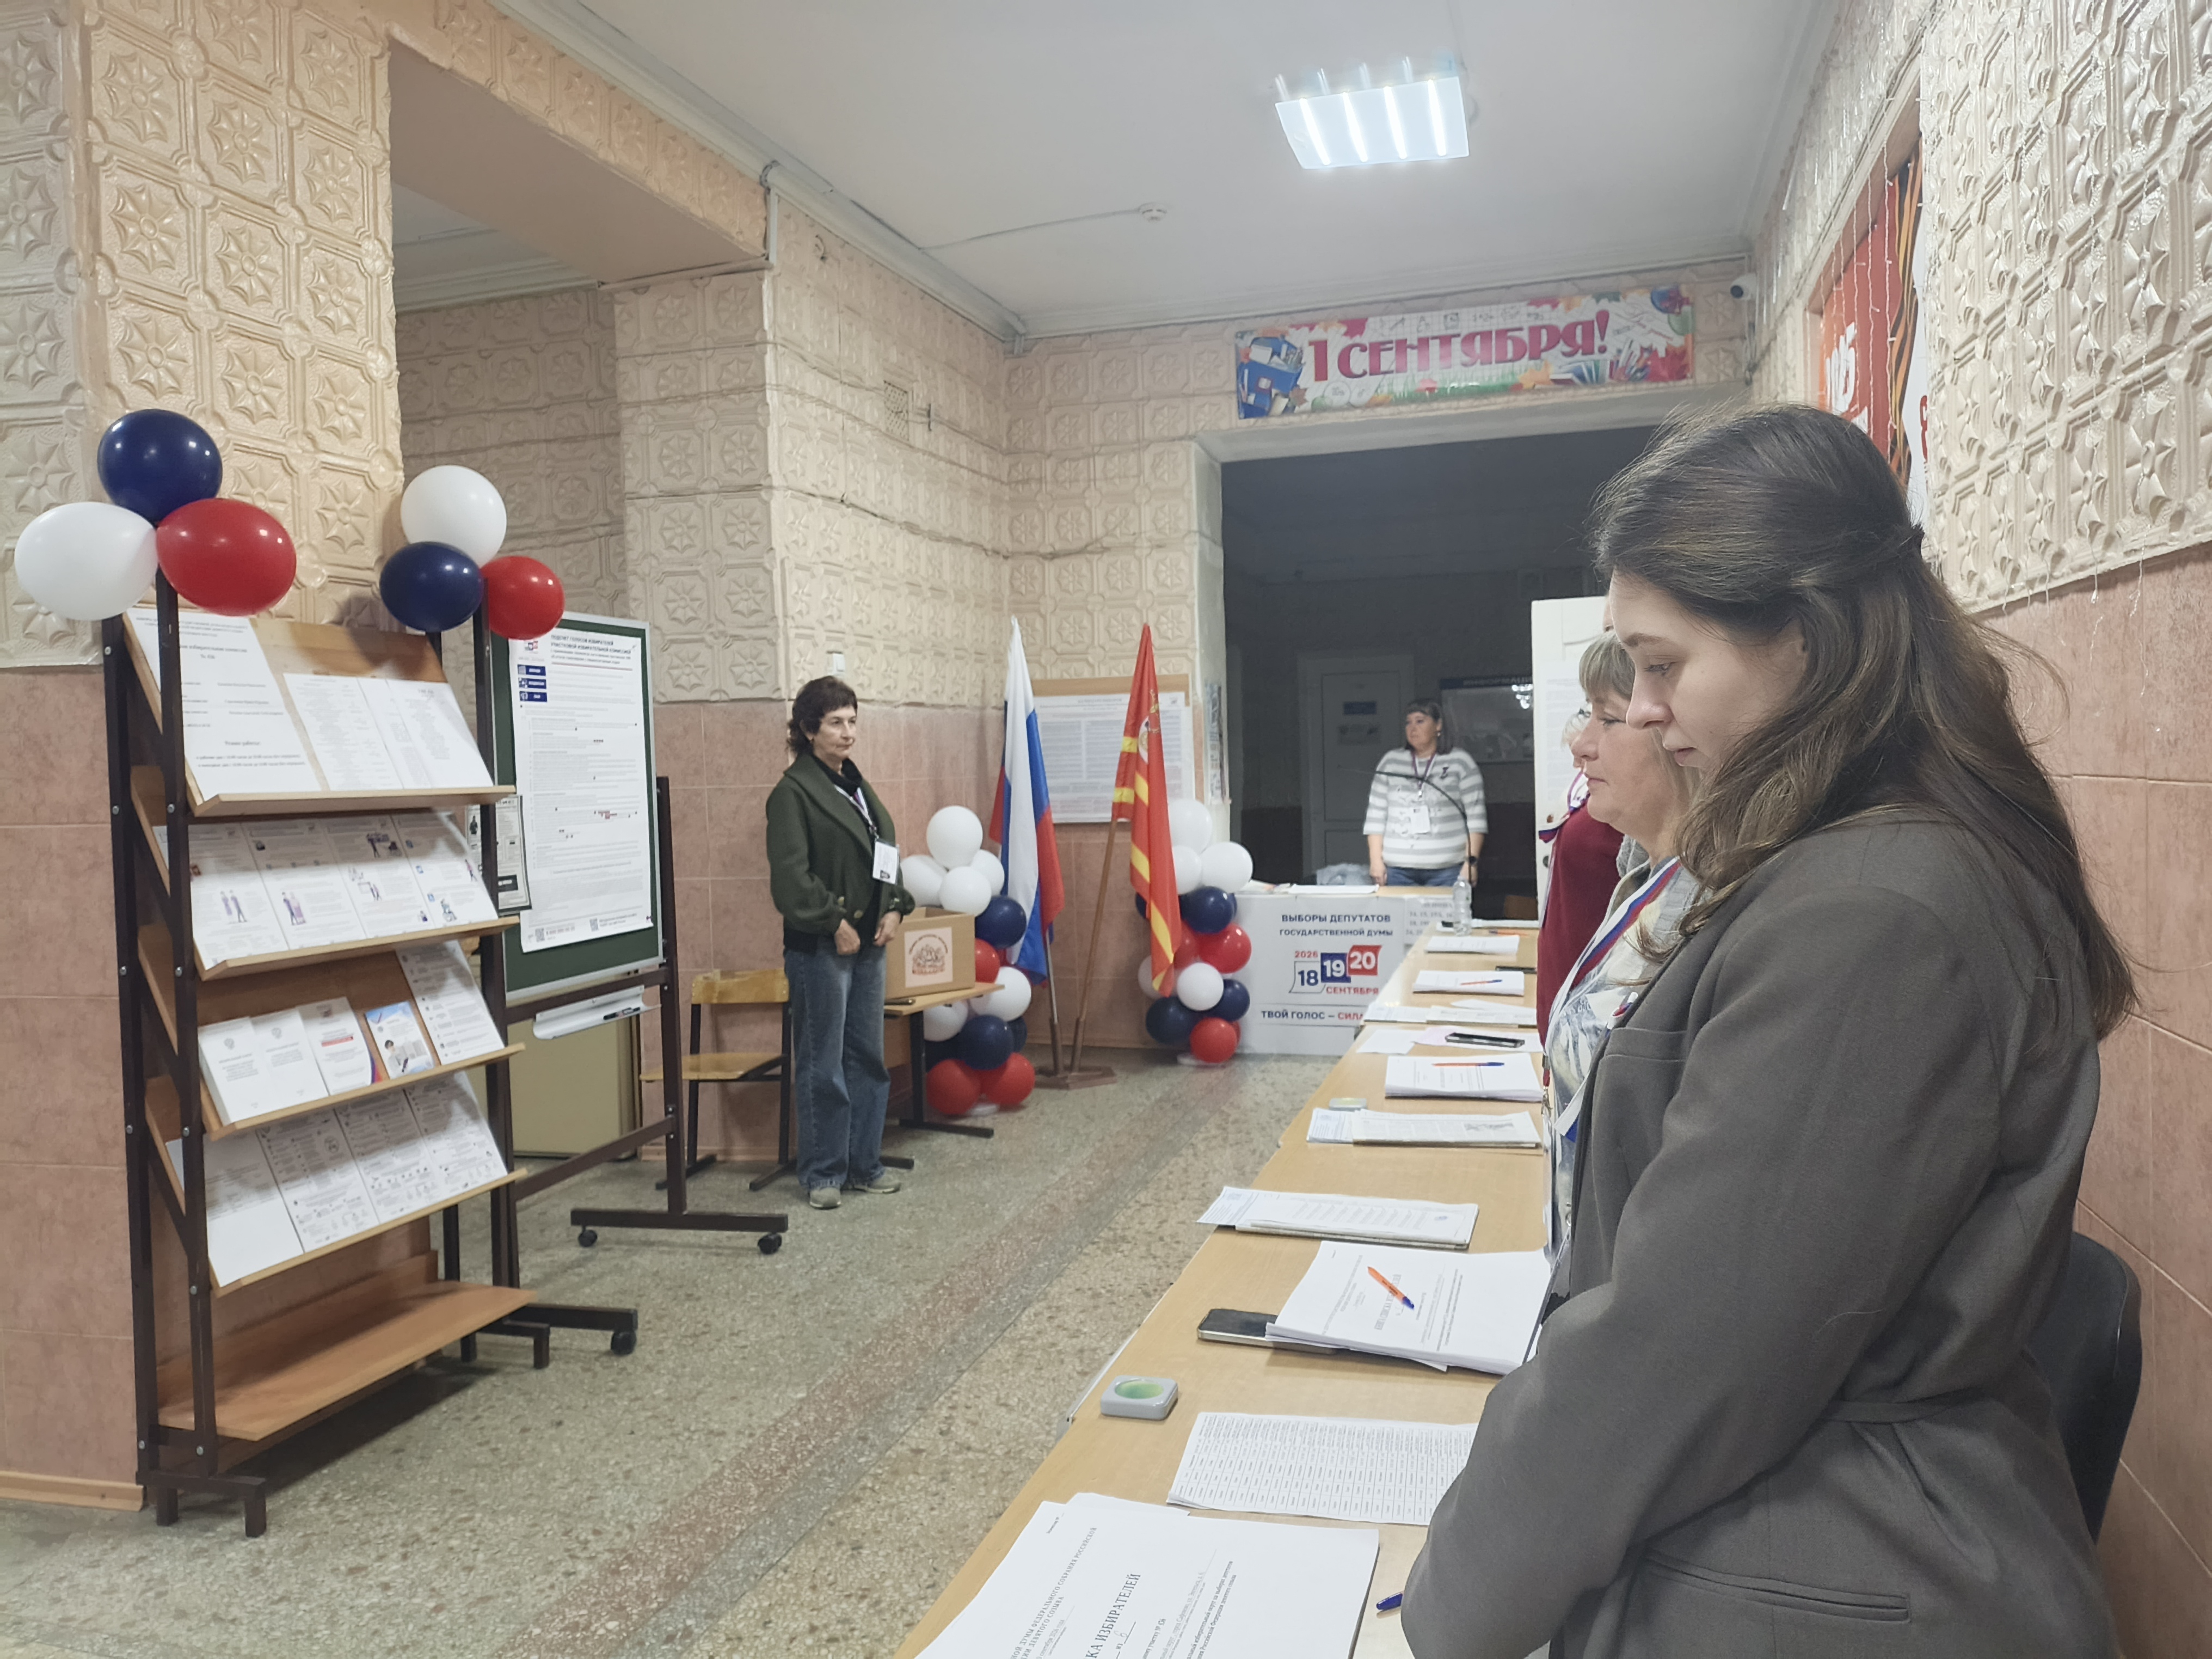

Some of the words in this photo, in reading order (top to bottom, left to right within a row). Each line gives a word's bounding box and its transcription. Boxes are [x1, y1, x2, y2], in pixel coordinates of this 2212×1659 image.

[1308, 339, 1328, 382] 1
[1337, 310, 1609, 378] СЕНТЯБРЯ!
[1281, 914, 1327, 923] ВЫБОРЫ
[1330, 914, 1391, 923] ДЕПУТАТОВ
[1279, 927, 1365, 936] ГОСУДАРСТВЕННОЙ
[1298, 969, 1318, 986] 18
[1323, 960, 1345, 978] 19
[1350, 951, 1375, 969] 20
[1326, 986, 1379, 995] СЕНТЯБРЯ
[1261, 1009, 1288, 1019] ТВОЙ
[1291, 1011, 1325, 1020] ГОЛОС
[1095, 1574, 1140, 1641] ИЗБИРАТЕЛЕЙ
